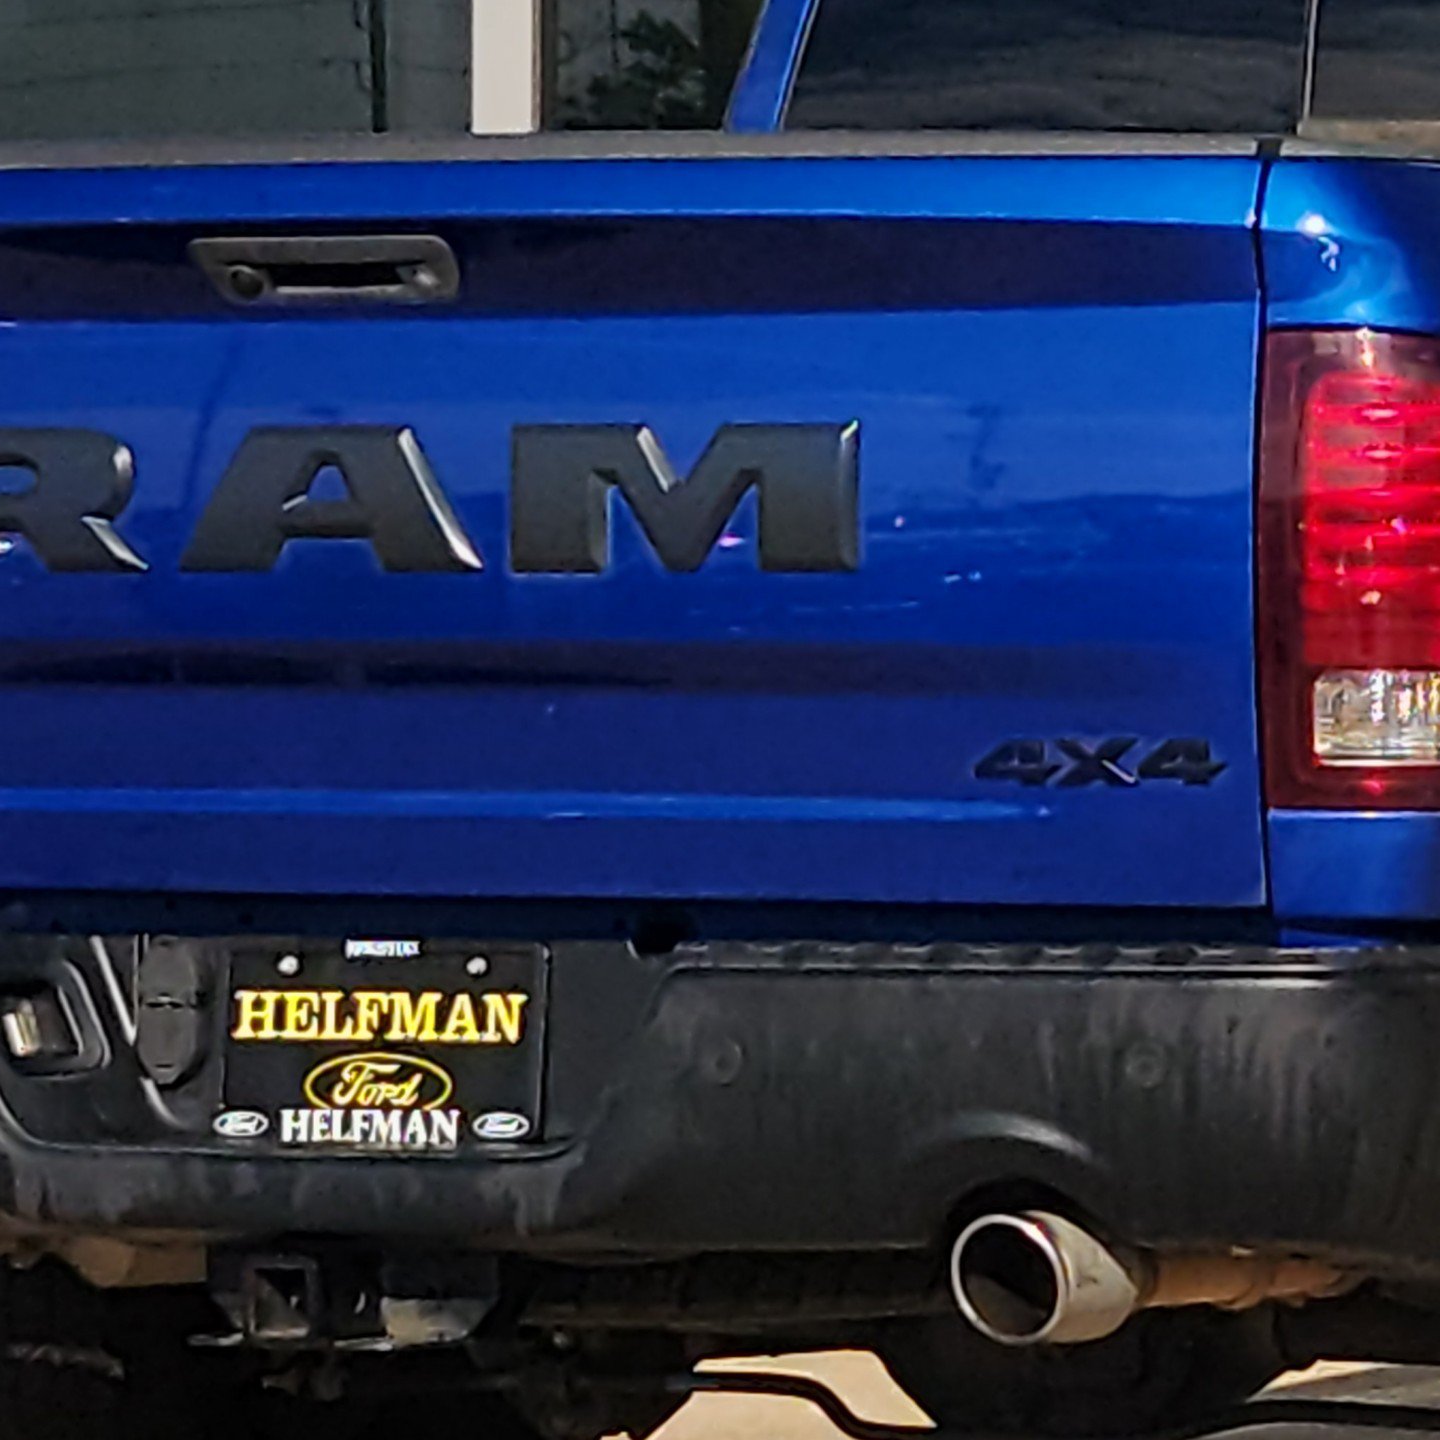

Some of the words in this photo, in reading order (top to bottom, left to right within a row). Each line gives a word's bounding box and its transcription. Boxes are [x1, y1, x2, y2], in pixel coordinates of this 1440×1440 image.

[230, 990, 529, 1044] HELFMAN
[332, 1060, 425, 1107] Ford
[279, 1109, 462, 1149] HELFMAN
